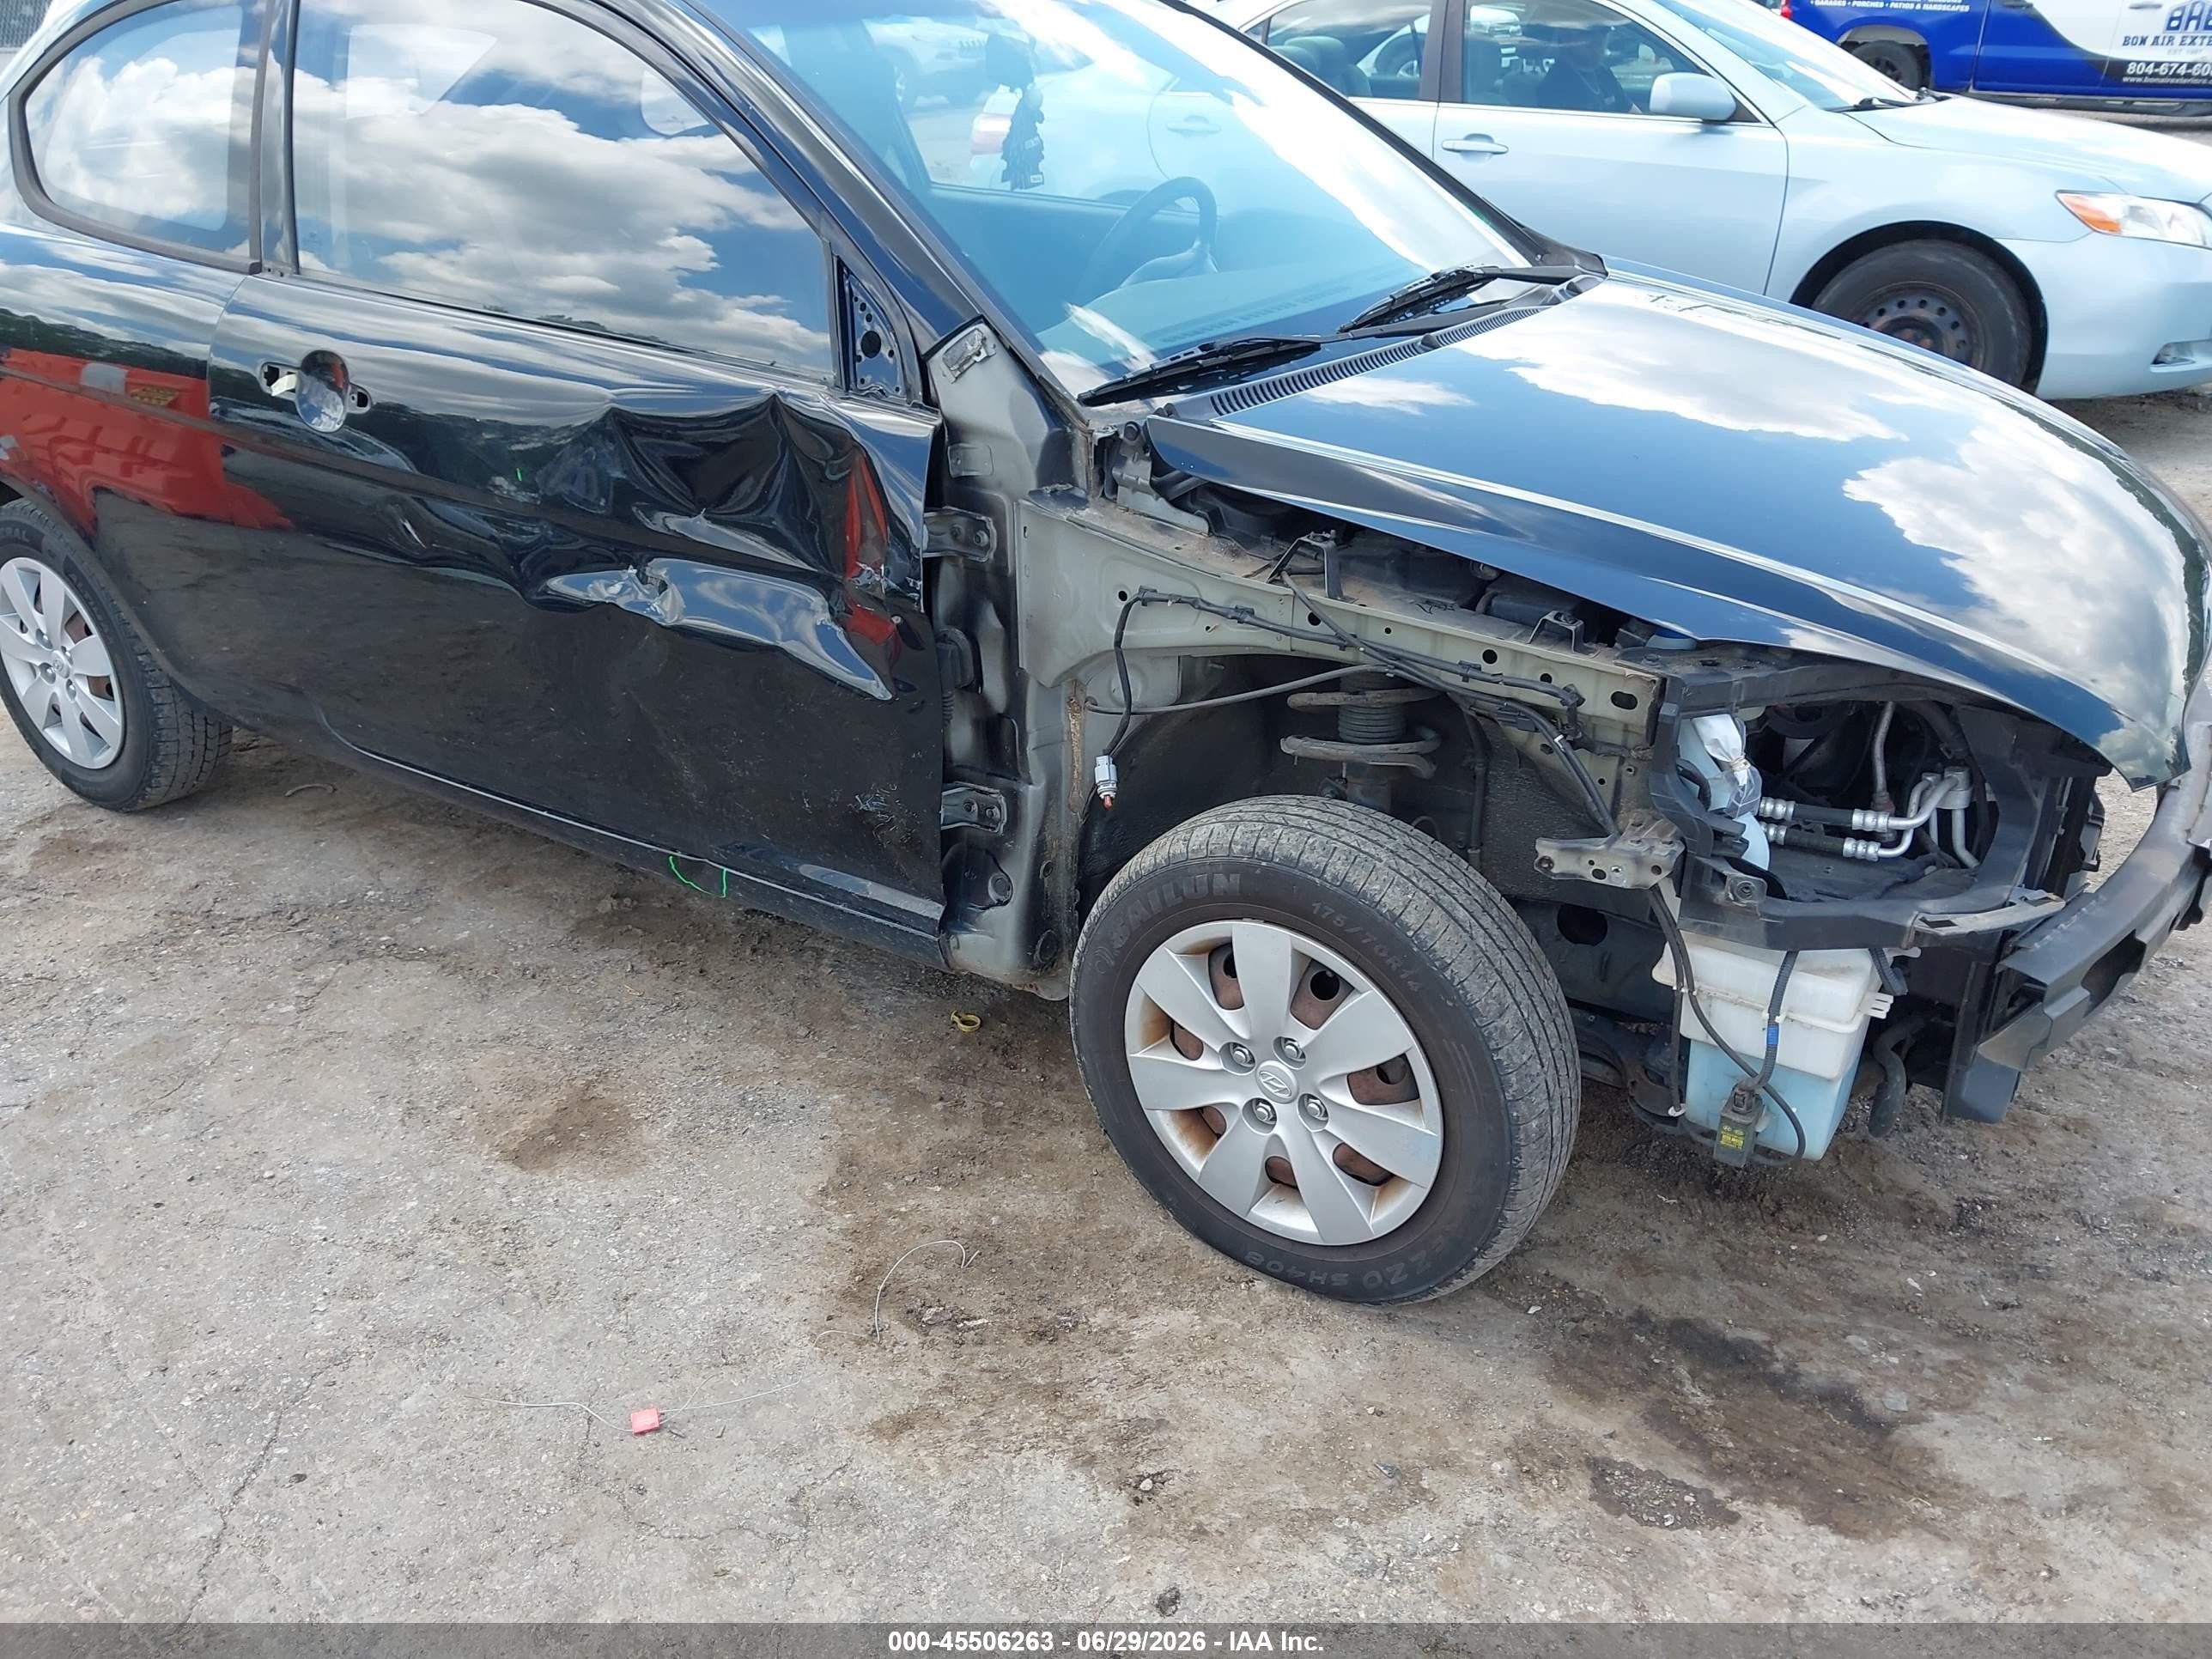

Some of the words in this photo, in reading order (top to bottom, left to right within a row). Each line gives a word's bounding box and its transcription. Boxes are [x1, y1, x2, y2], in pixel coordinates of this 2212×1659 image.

[2122, 36, 2148, 46] BON
[2150, 36, 2175, 46] AIR
[2126, 62, 2212, 76] 804-674-60
